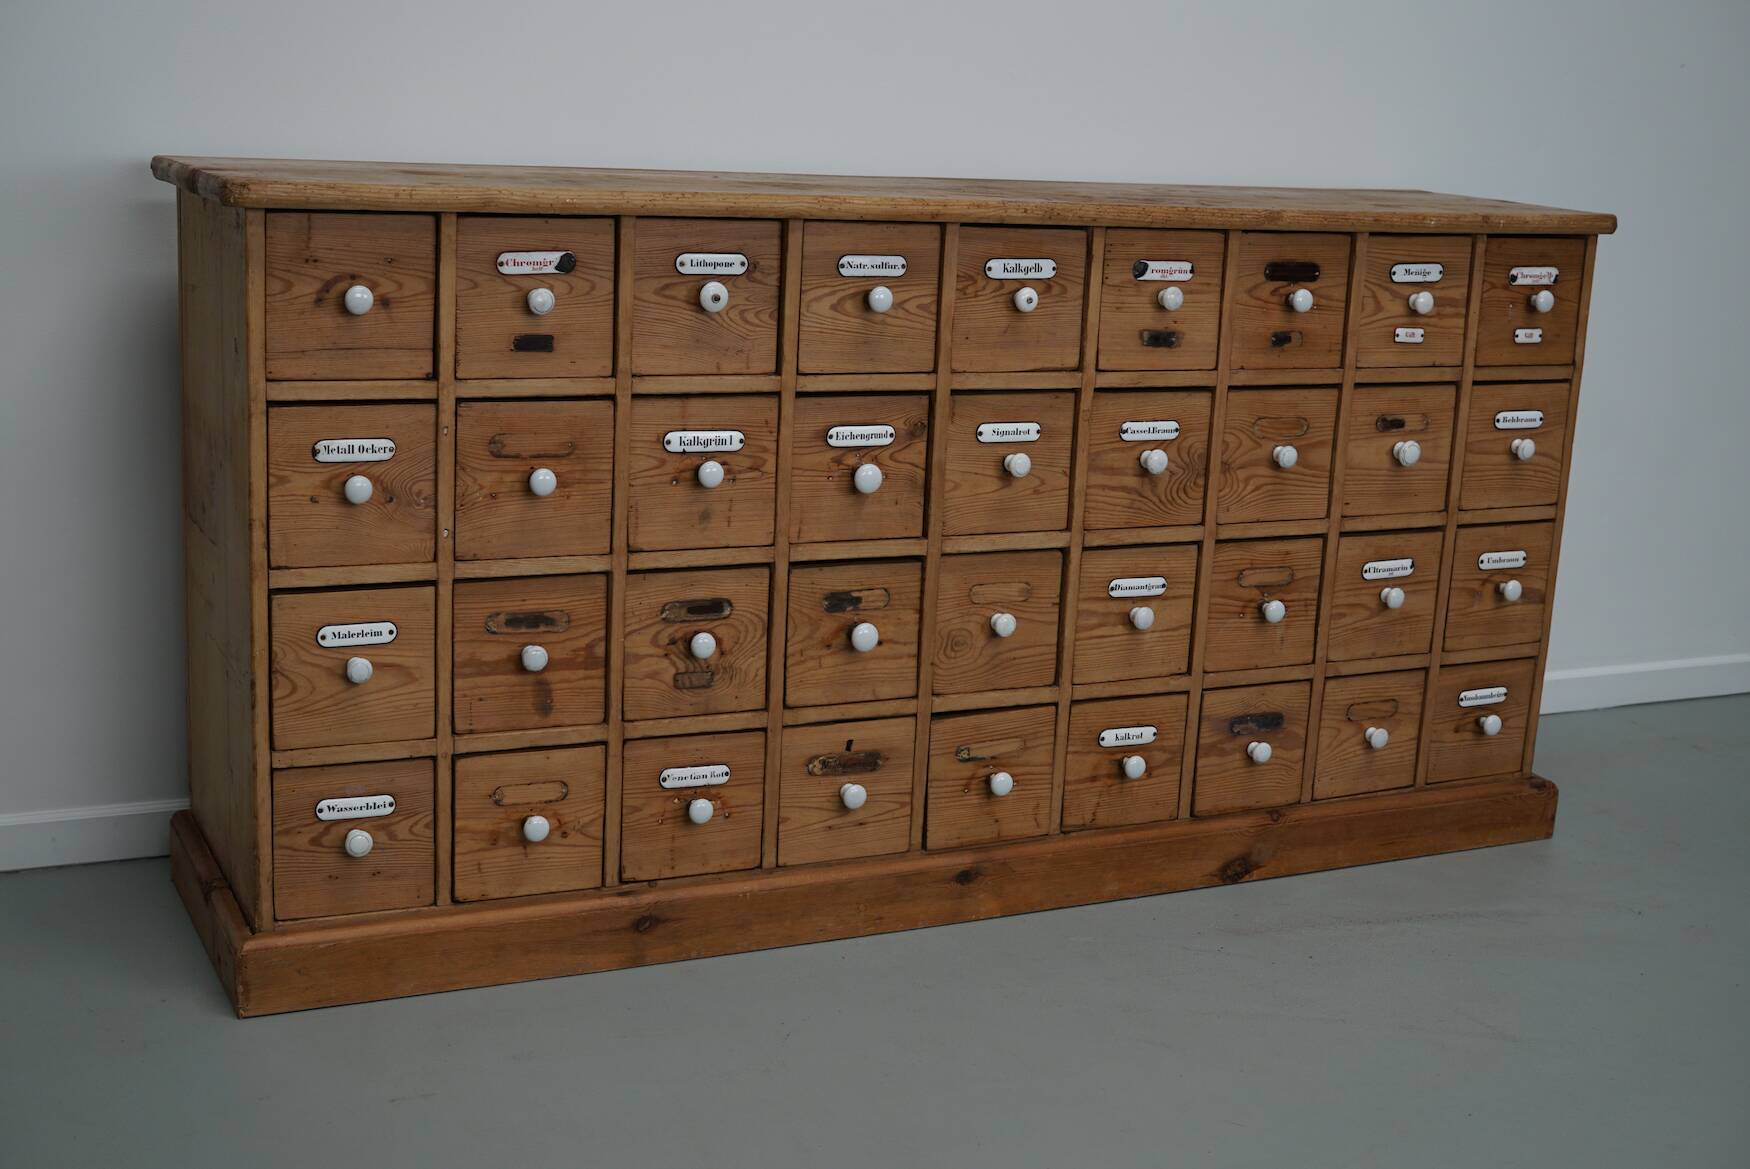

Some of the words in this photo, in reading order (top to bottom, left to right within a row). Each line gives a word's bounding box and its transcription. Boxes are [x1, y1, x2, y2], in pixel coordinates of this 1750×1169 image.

[505, 258, 554, 267] Chromgr
[690, 258, 735, 270] Lithopone
[1003, 263, 1043, 275] Kalkgelb
[1404, 268, 1431, 277] Menige
[836, 430, 888, 442] Eichengrund
[991, 428, 1030, 438] Signalrot
[679, 435, 727, 448] Kalkgrün
[331, 629, 383, 640] Malerleim
[1115, 732, 1143, 742] Kalkrot
[327, 801, 386, 812] Wasserblei
